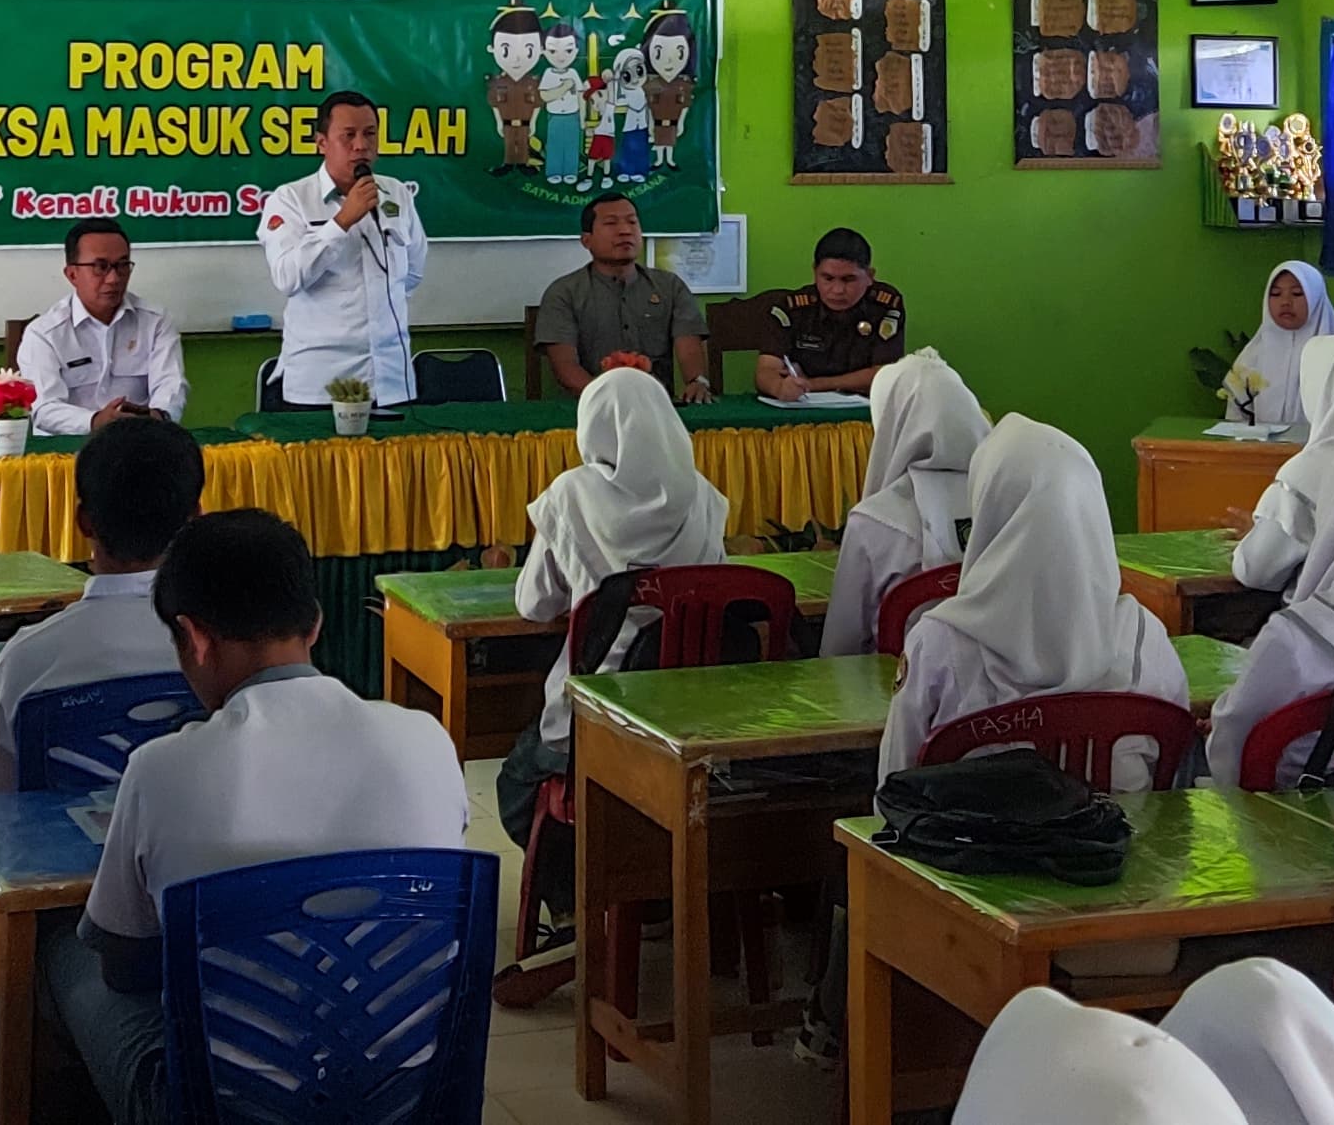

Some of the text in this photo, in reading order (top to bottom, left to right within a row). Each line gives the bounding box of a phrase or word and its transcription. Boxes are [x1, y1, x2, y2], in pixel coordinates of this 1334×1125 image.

[69, 41, 325, 91] PROGRAM
[85, 105, 251, 158] MASUK
[260, 105, 467, 156] SELAH
[12, 185, 119, 218] Kenali
[125, 186, 231, 217] Hukum
[521, 182, 559, 203] SATYA
[969, 706, 1044, 740] TASHA
